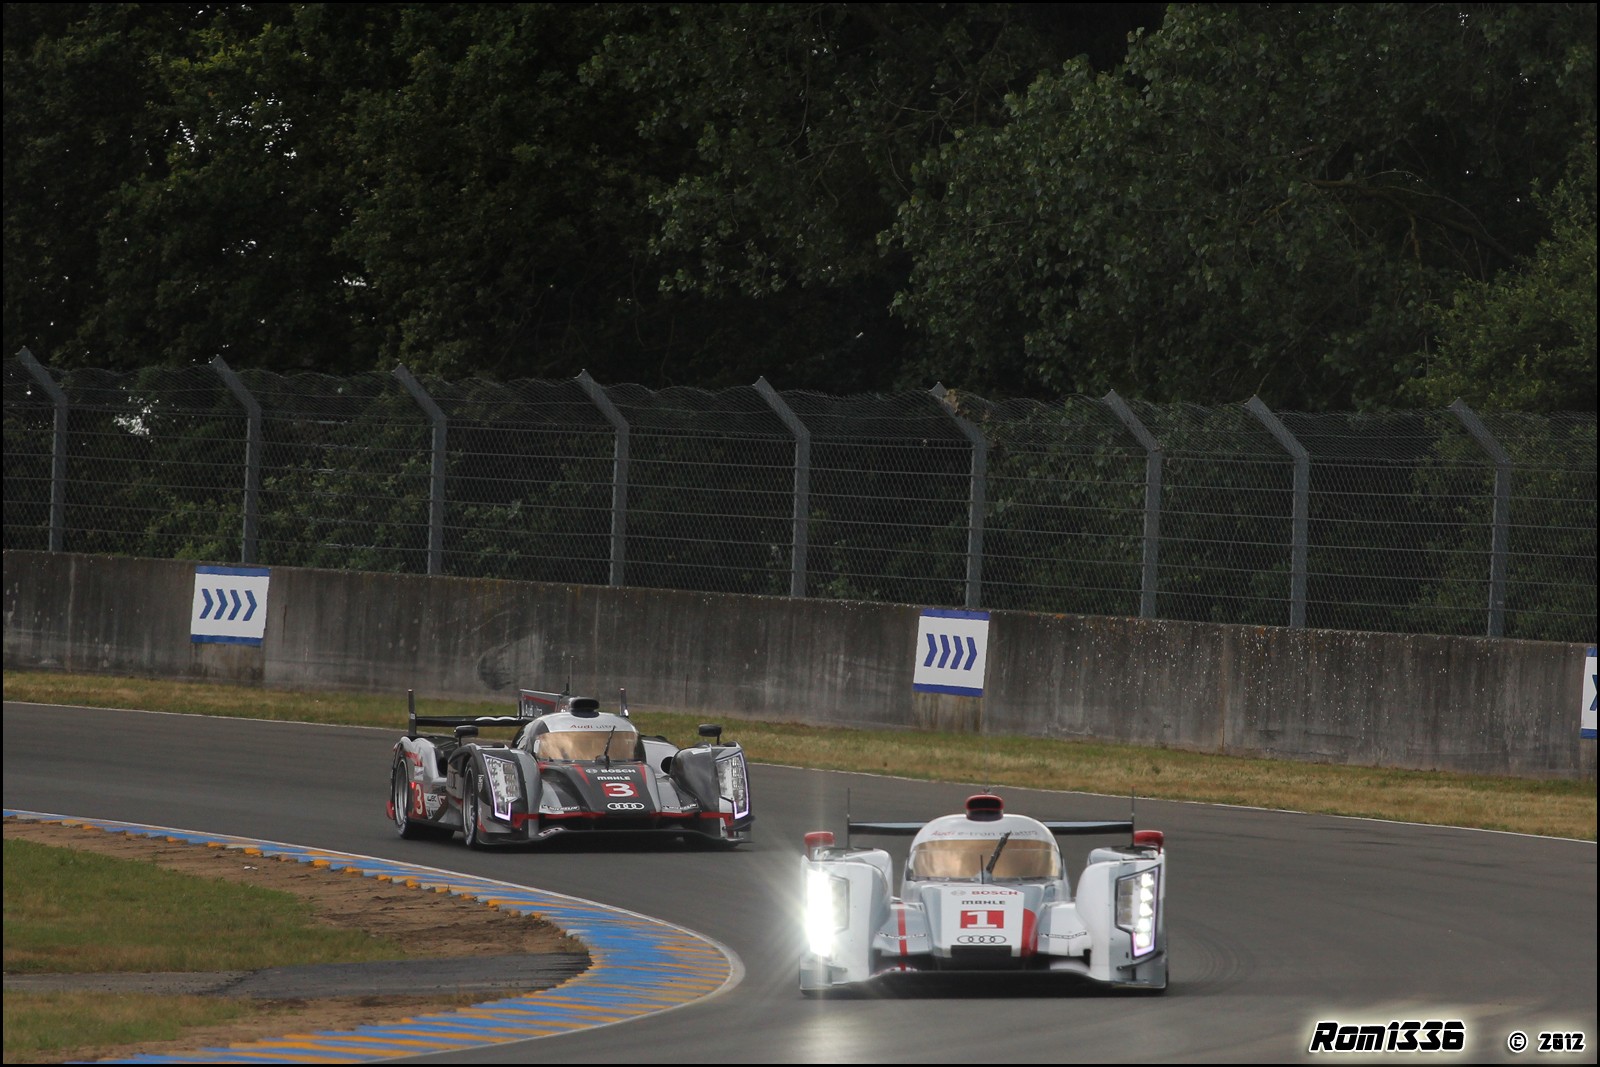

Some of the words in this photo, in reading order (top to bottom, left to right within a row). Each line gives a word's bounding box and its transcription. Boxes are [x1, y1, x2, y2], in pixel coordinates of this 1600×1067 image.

[605, 782, 634, 798] 3
[416, 784, 423, 815] 3
[967, 911, 997, 928] 1
